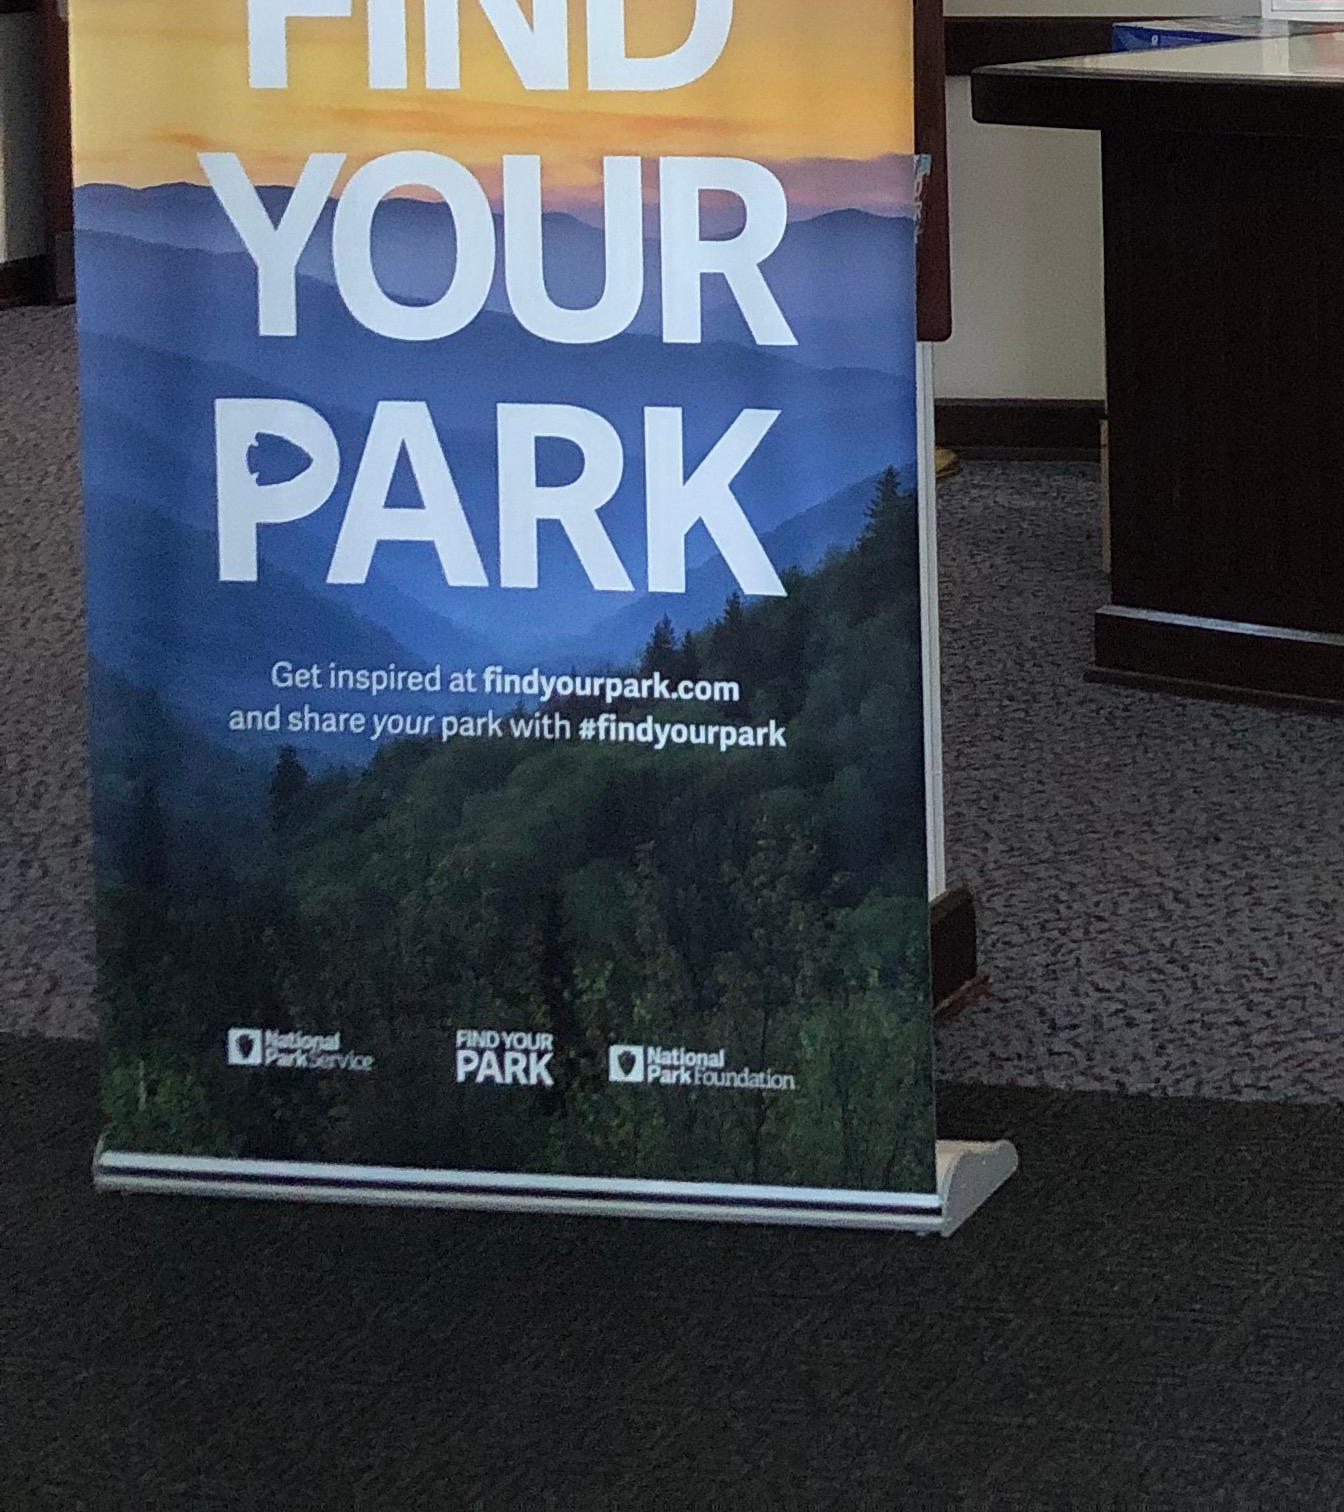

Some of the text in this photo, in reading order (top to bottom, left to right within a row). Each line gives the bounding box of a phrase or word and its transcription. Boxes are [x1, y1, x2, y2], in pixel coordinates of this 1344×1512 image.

[197, 150, 799, 346] YOUR
[213, 398, 788, 598] PARK
[271, 661, 740, 704] Get inspired at findyourpark.com
[228, 704, 787, 752] and share your park with #findyourpark
[265, 1029, 342, 1051] National
[456, 1029, 554, 1050] FIND YOUR
[648, 1046, 726, 1070] National
[455, 1049, 555, 1086] PARK
[648, 1065, 796, 1090] Park Foundation
